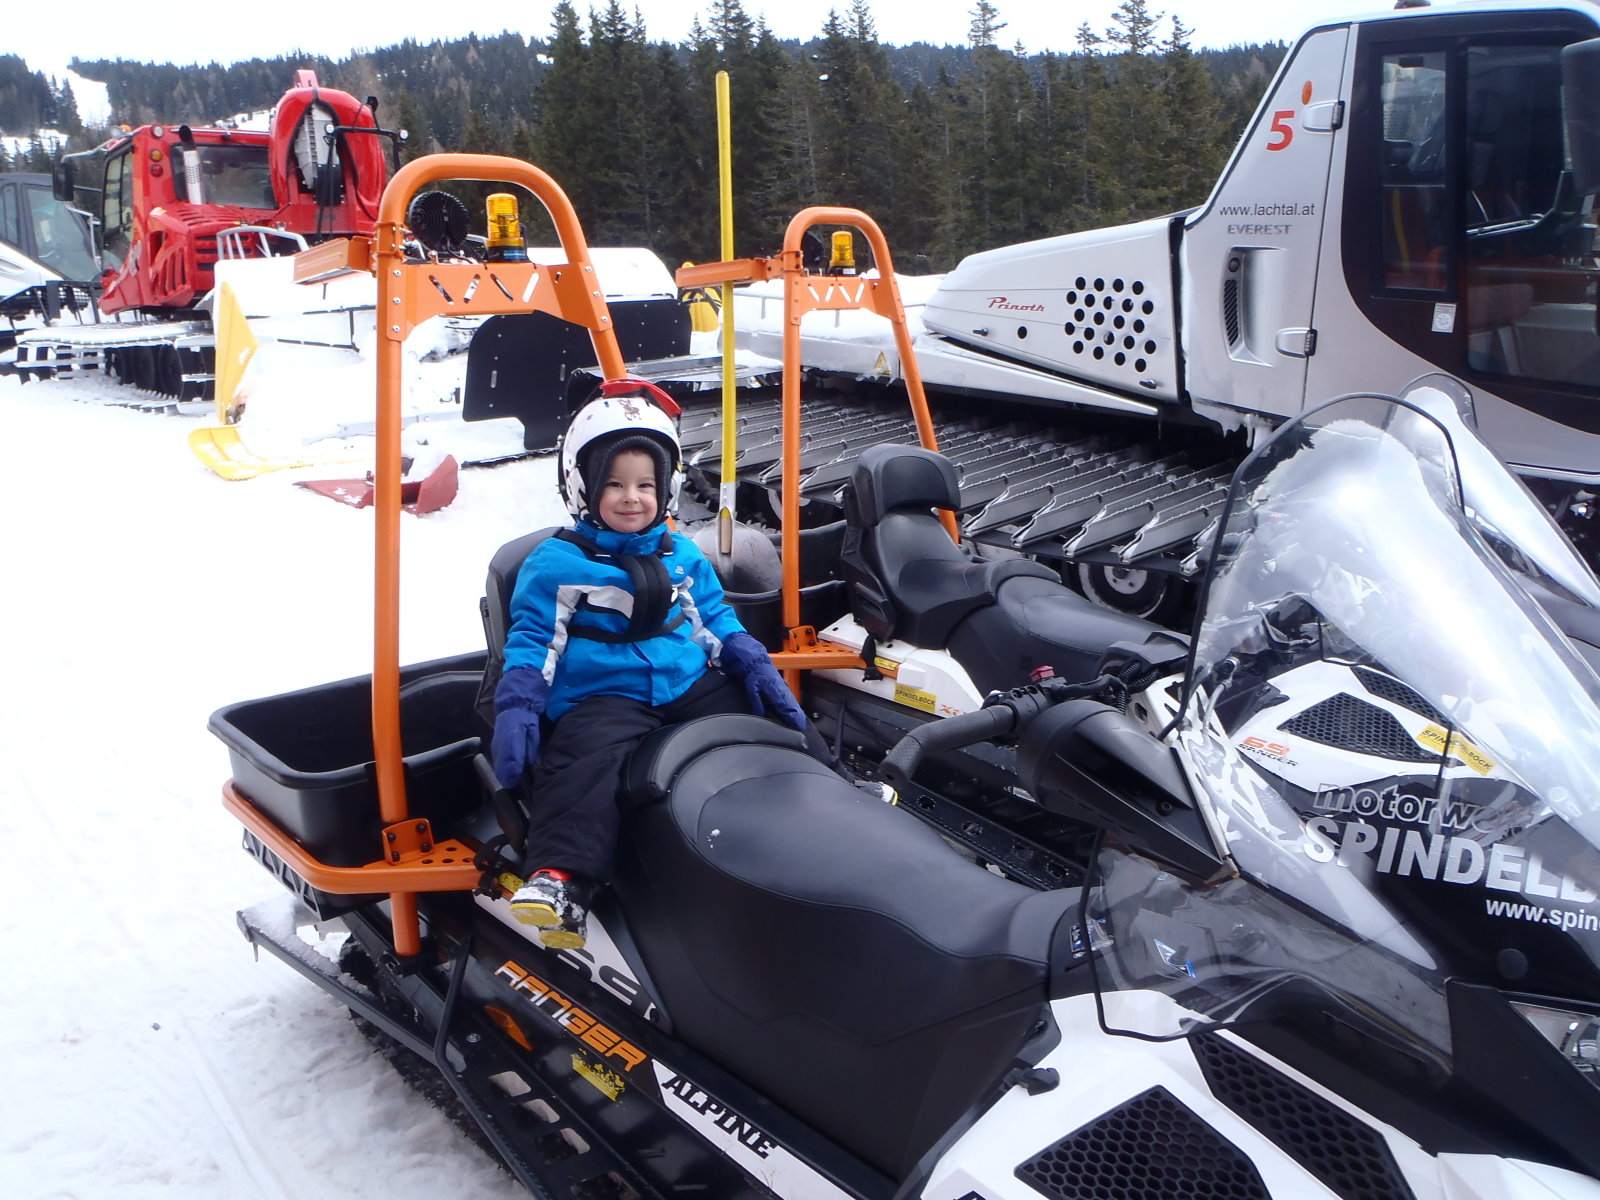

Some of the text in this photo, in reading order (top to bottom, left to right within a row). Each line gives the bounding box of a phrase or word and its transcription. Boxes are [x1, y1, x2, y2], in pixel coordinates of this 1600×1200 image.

[1266, 110, 1295, 151] 5
[1219, 203, 1315, 216] www.lachtal.at
[1227, 224, 1292, 235] EVEREST
[986, 296, 1045, 312] Prinoth
[1243, 736, 1290, 756] 69
[1486, 899, 1600, 932] www.spin
[495, 960, 647, 1072] RANGER
[661, 1073, 778, 1161] ALPINE
